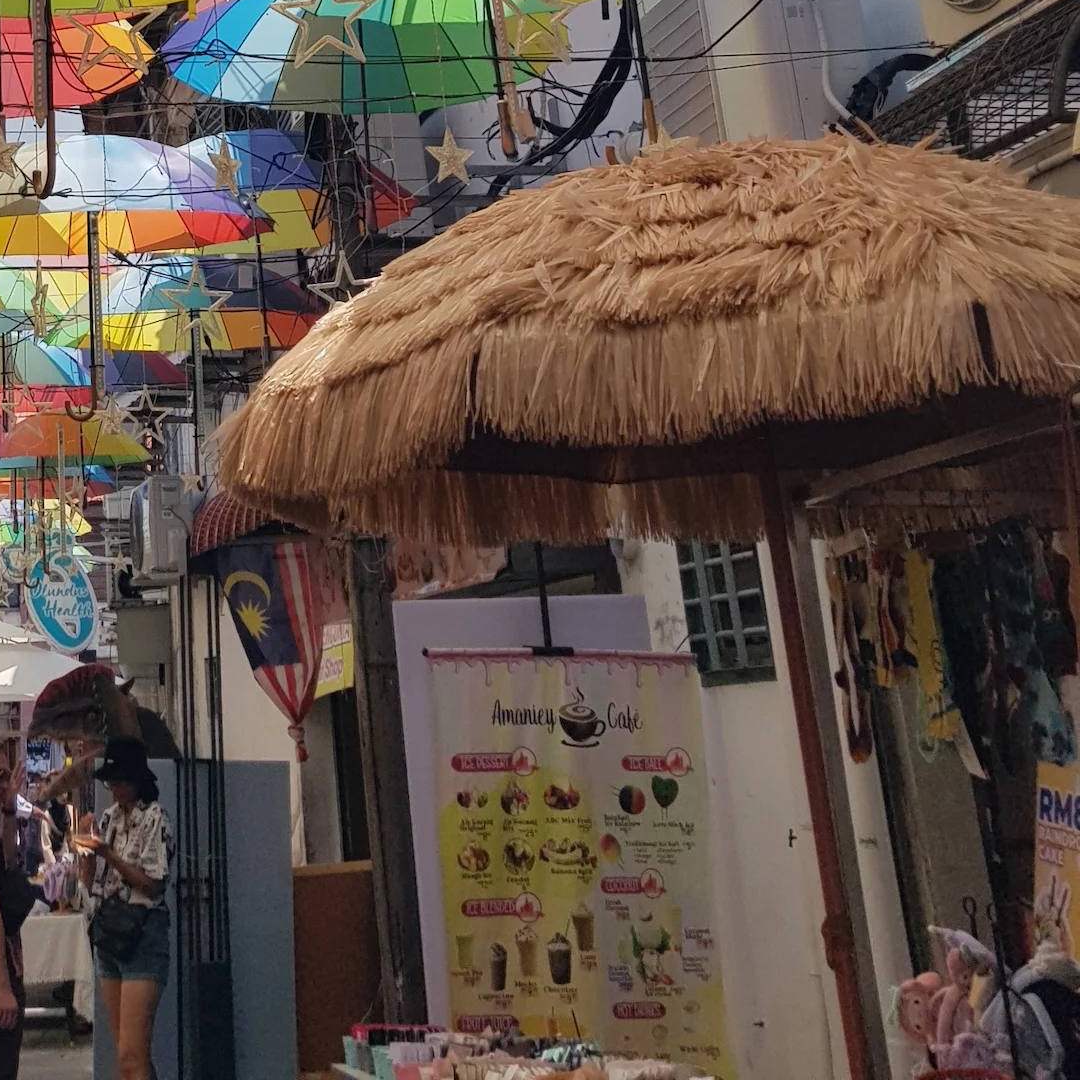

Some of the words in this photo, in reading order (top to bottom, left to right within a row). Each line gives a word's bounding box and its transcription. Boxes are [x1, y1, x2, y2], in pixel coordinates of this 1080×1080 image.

[42, 600, 94, 618] Health
[491, 699, 557, 734] Amaniey
[460, 756, 475, 769] ICE
[476, 756, 509, 769] DESSERT
[628, 758, 644, 769] ICE
[480, 902, 515, 914] BLENDED
